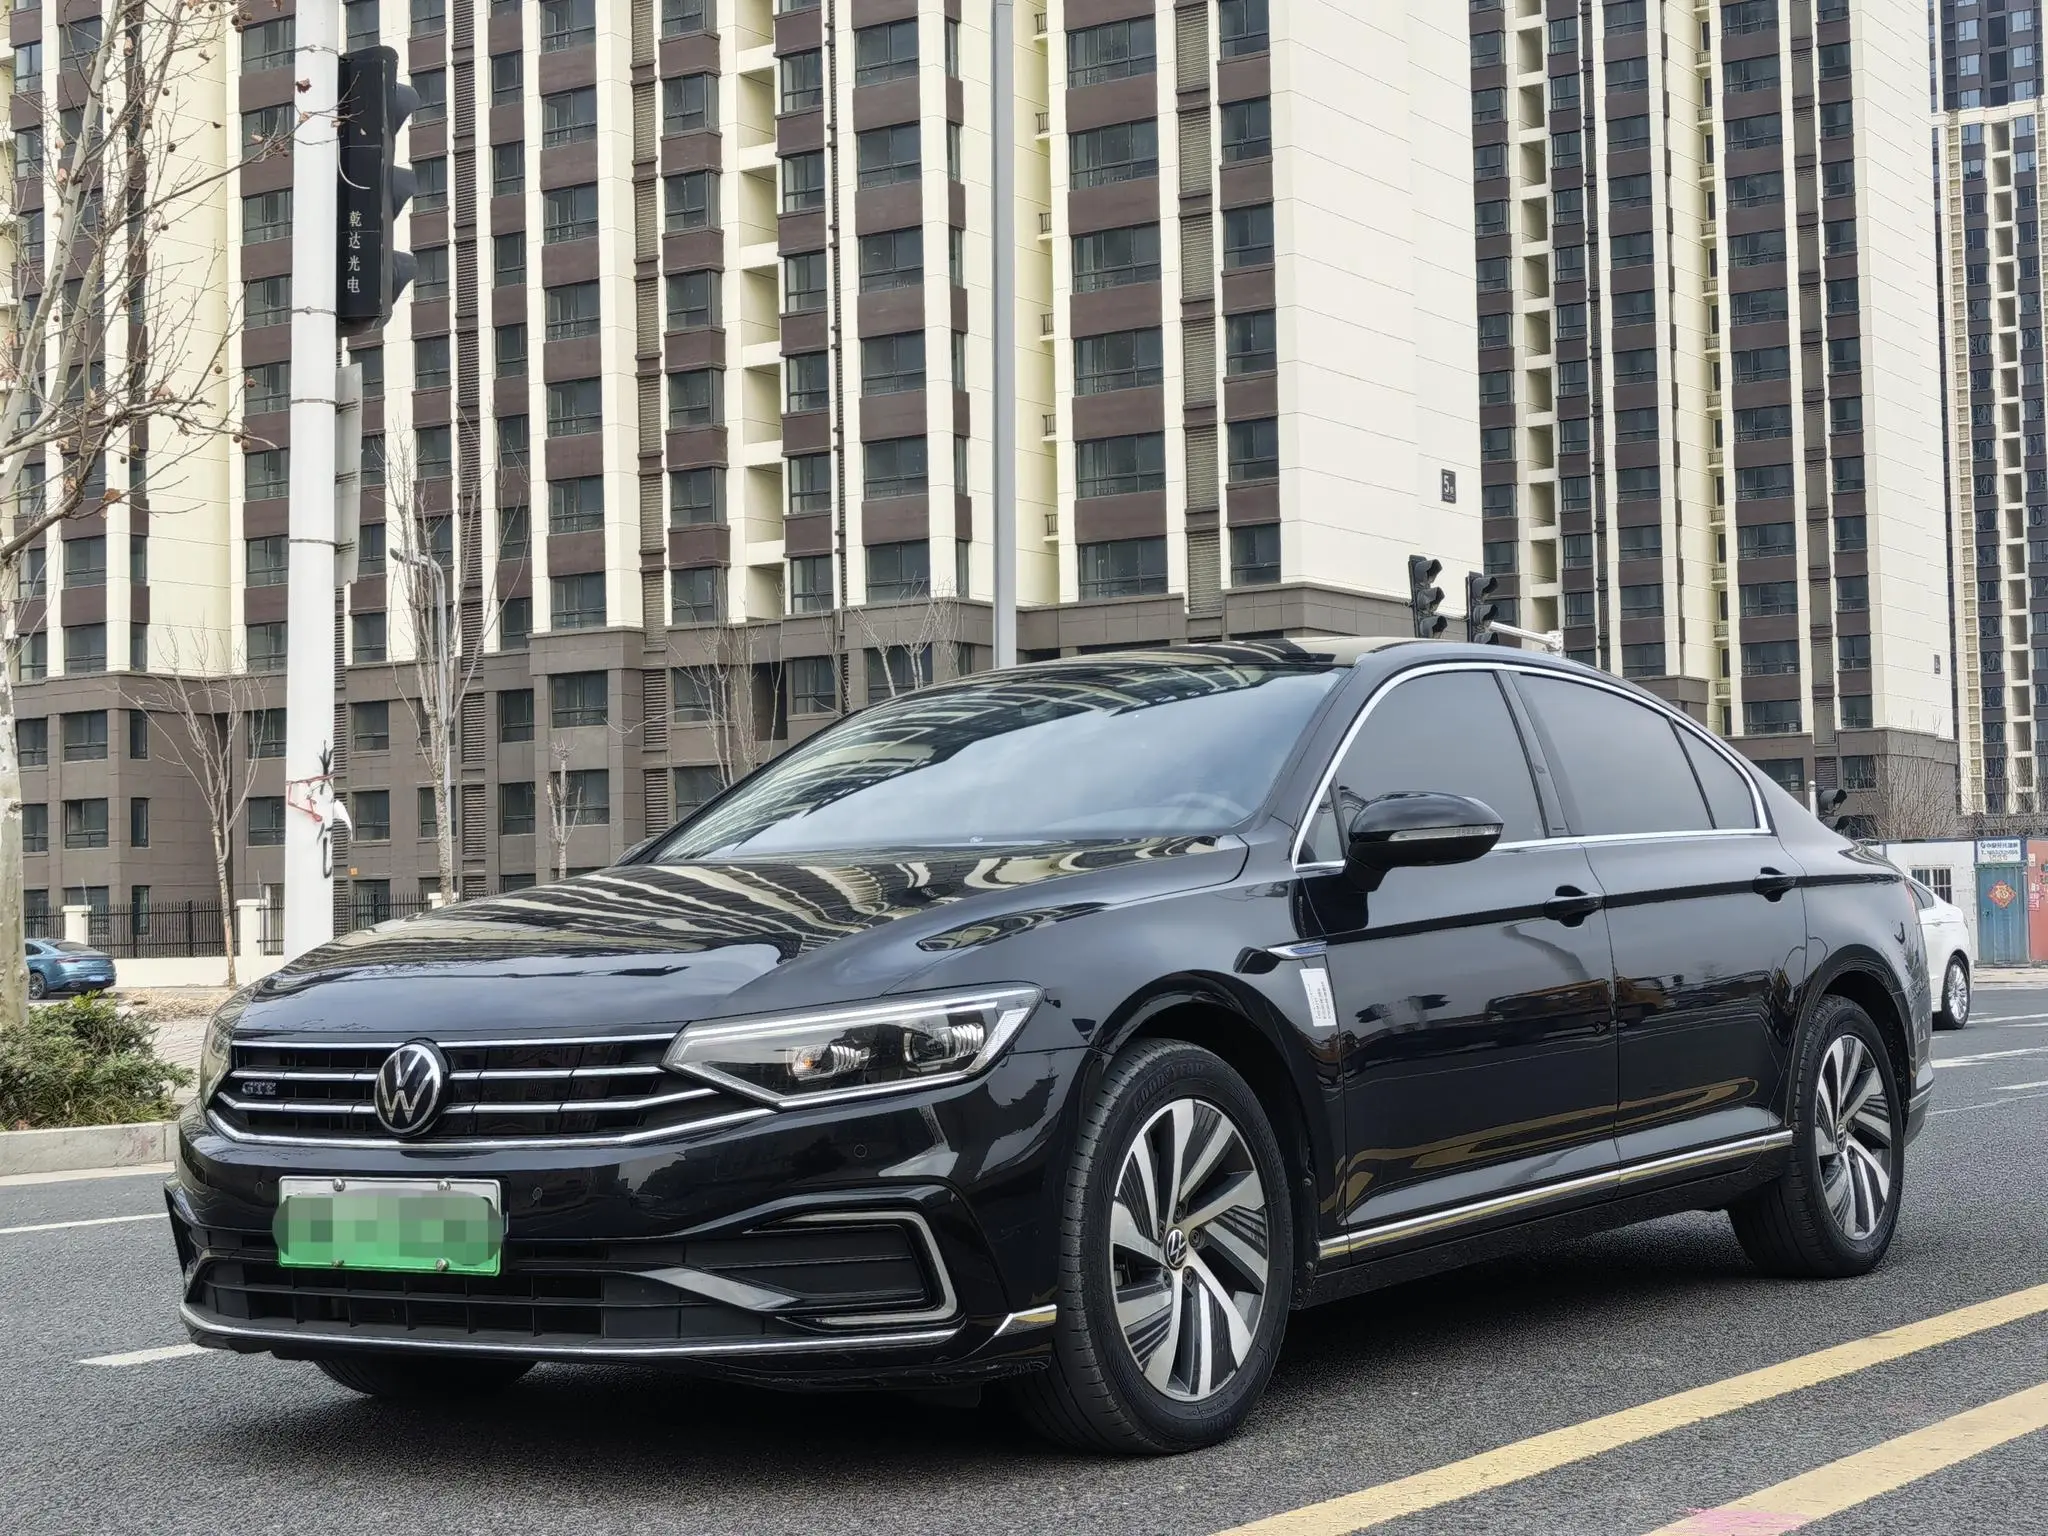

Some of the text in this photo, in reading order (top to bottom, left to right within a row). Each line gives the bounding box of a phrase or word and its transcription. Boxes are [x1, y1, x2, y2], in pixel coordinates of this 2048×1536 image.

[347, 210, 362, 293] 乾达光电
[242, 1081, 277, 1096] GTE
